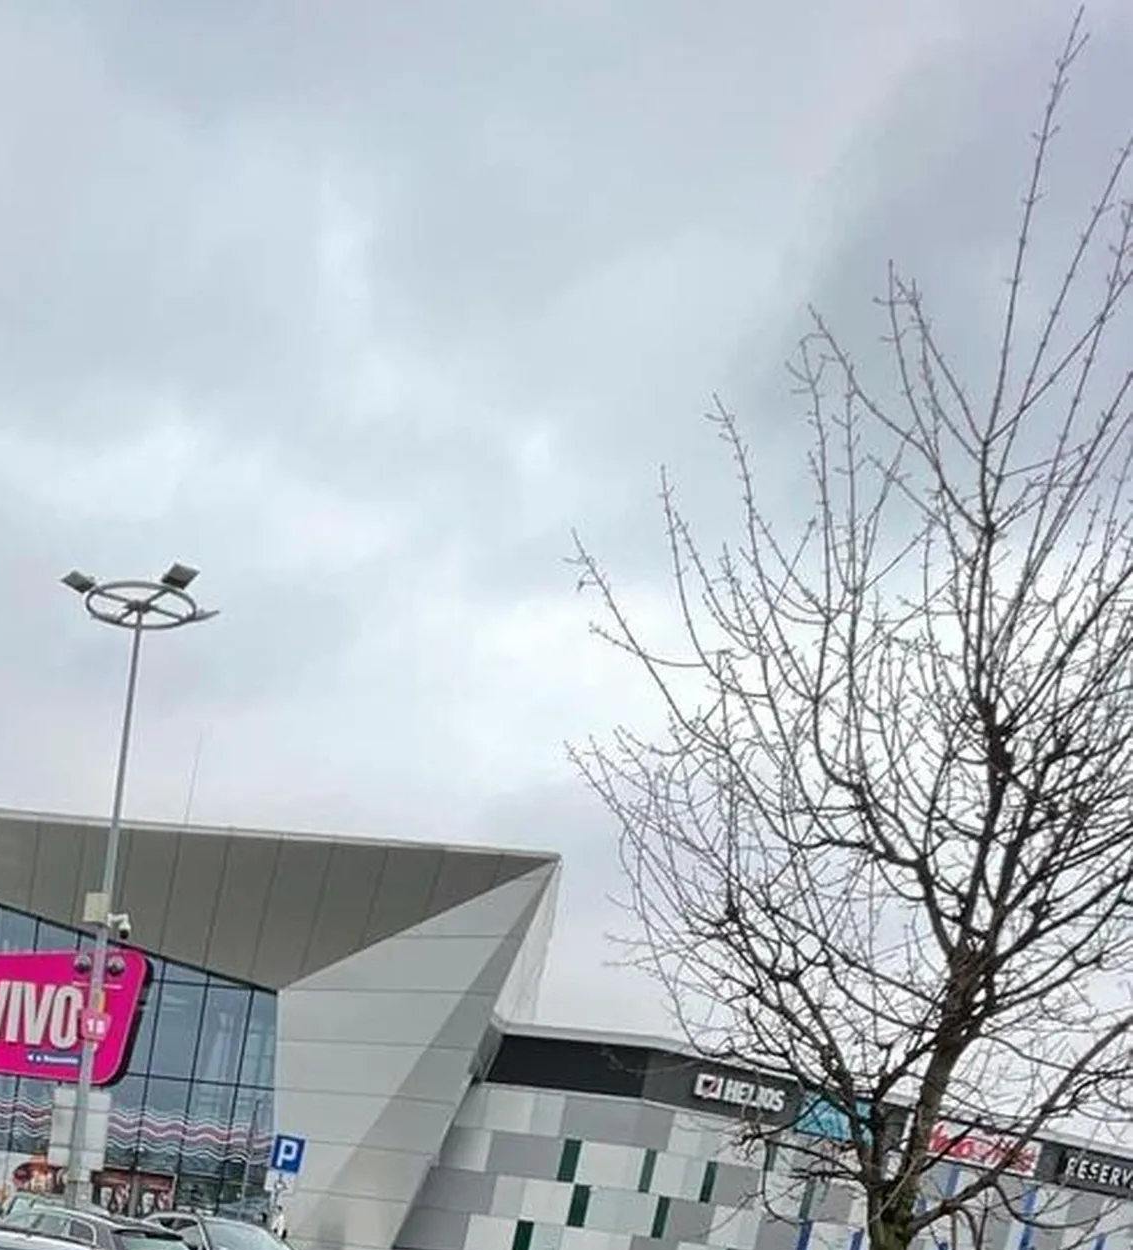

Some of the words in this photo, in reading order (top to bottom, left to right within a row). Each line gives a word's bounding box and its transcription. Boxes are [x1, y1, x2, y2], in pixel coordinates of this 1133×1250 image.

[722, 1077, 786, 1113] HELIOS
[276, 1138, 299, 1167] P
[1065, 1156, 1133, 1190] RESERV
